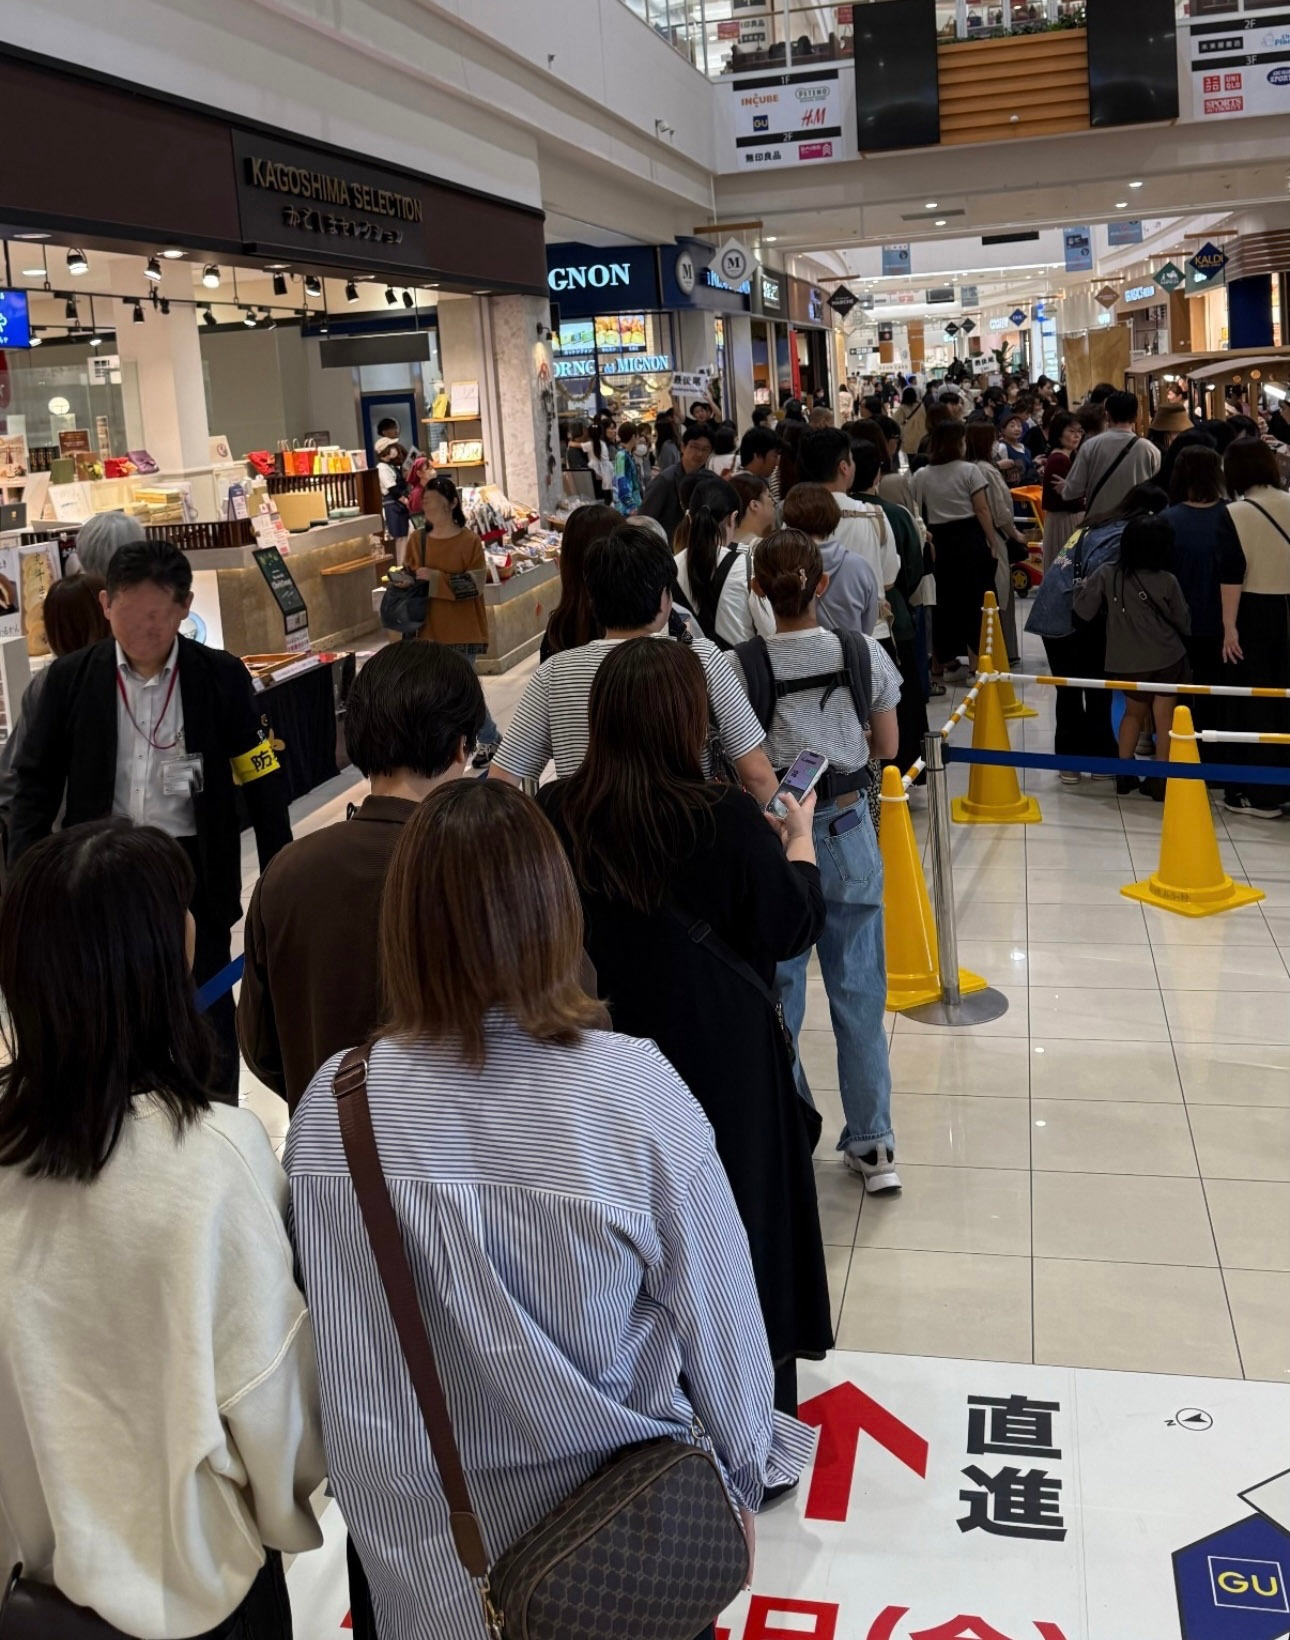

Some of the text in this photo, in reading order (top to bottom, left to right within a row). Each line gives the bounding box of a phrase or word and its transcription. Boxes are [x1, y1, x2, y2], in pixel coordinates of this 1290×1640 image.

[1244, 19, 1257, 29] 2F
[1246, 55, 1257, 65] 3F
[781, 75, 791, 85] 1F
[741, 94, 779, 107] INCUBE
[1206, 98, 1241, 108] SPORTS
[754, 117, 768, 128] GU
[802, 107, 826, 126] H&M
[783, 132, 793, 141] 2F
[745, 151, 782, 163] 無印良品
[250, 157, 423, 222] KAGOSHIMA SELECTION
[727, 257, 741, 269] M
[1194, 254, 1223, 265] KALDI
[547, 263, 631, 291] GNON
[682, 264, 693, 279] M
[616, 355, 669, 373] MIGNON
[1164, 1419, 1176, 1427] N
[957, 1394, 1068, 1542] 直進
[1217, 1571, 1279, 1597] GU
